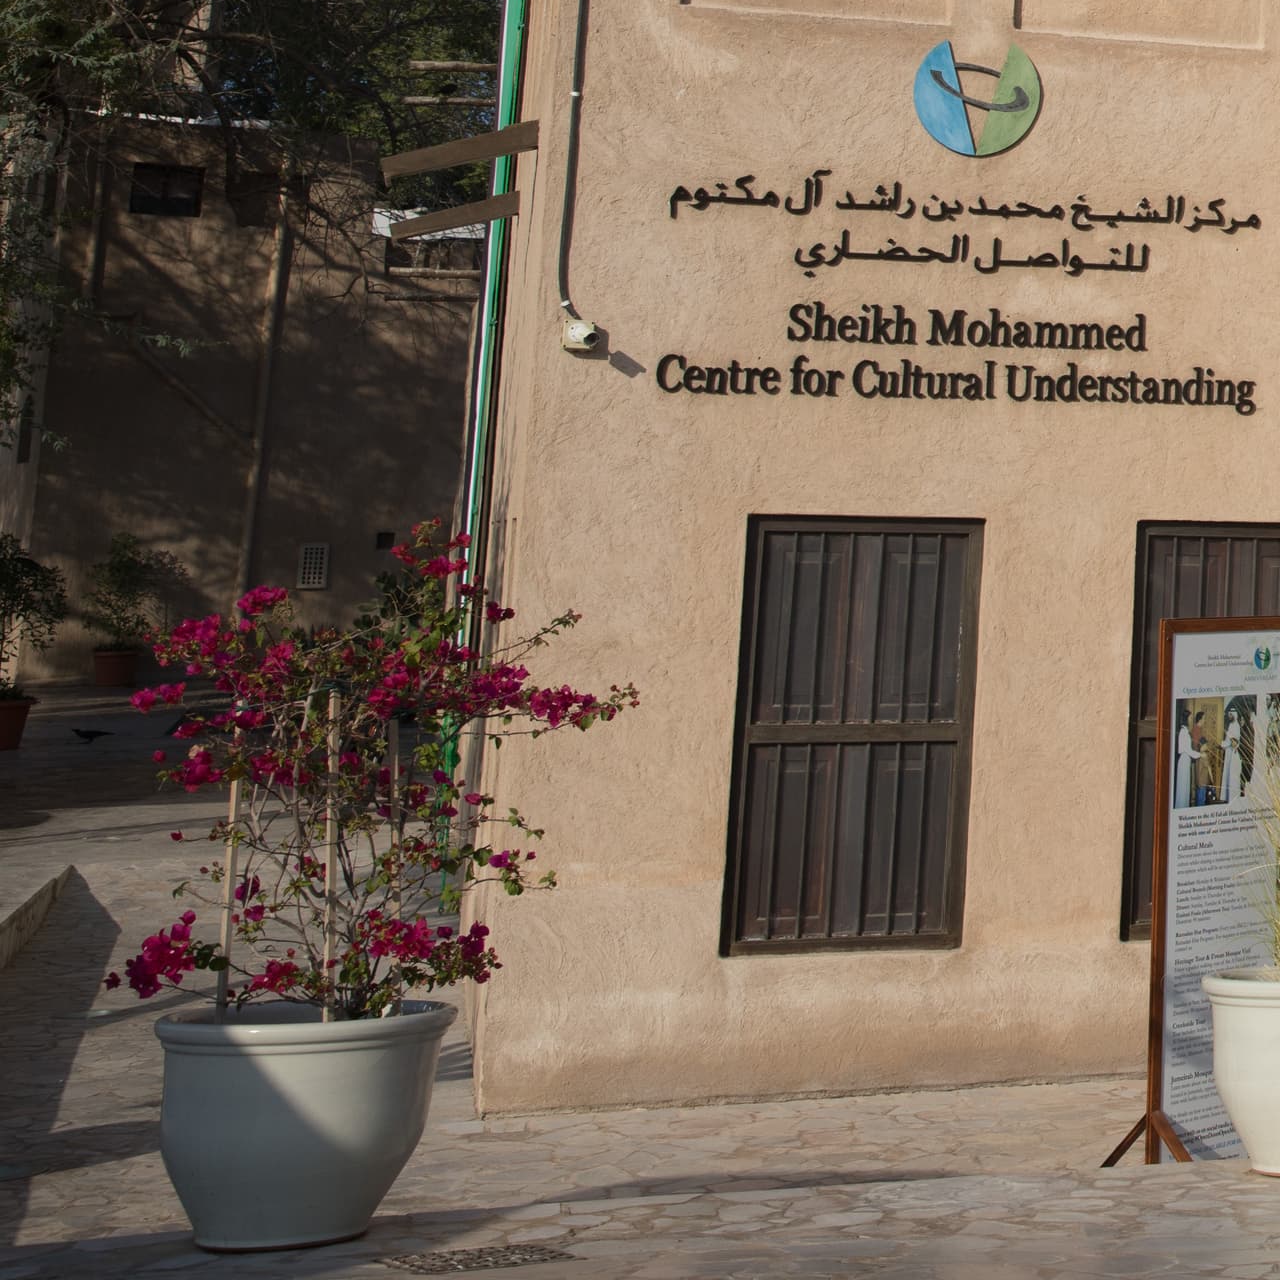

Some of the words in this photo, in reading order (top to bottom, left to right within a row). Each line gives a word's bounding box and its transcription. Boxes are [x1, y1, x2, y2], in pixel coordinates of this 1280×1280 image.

[670, 174, 780, 219] مكتوم
[785, 169, 833, 216] آل
[836, 181, 916, 219] راشد
[922, 194, 964, 222] بن
[968, 196, 1065, 220] محمد
[1070, 194, 1185, 231] الشيخ
[1184, 198, 1261, 234] مركز
[794, 229, 970, 278] الحضاري
[974, 237, 1150, 277] للتواصل
[787, 301, 917, 345] Sheikh
[925, 308, 1148, 352] Mohammed
[656, 353, 781, 396] Centre
[790, 354, 845, 397] for
[852, 358, 997, 400] Cultural
[1005, 364, 1257, 416] Understanding
[1182, 686, 1197, 695] Open
[1178, 842, 1198, 852] Cultural
[1199, 841, 1213, 849] Meals
